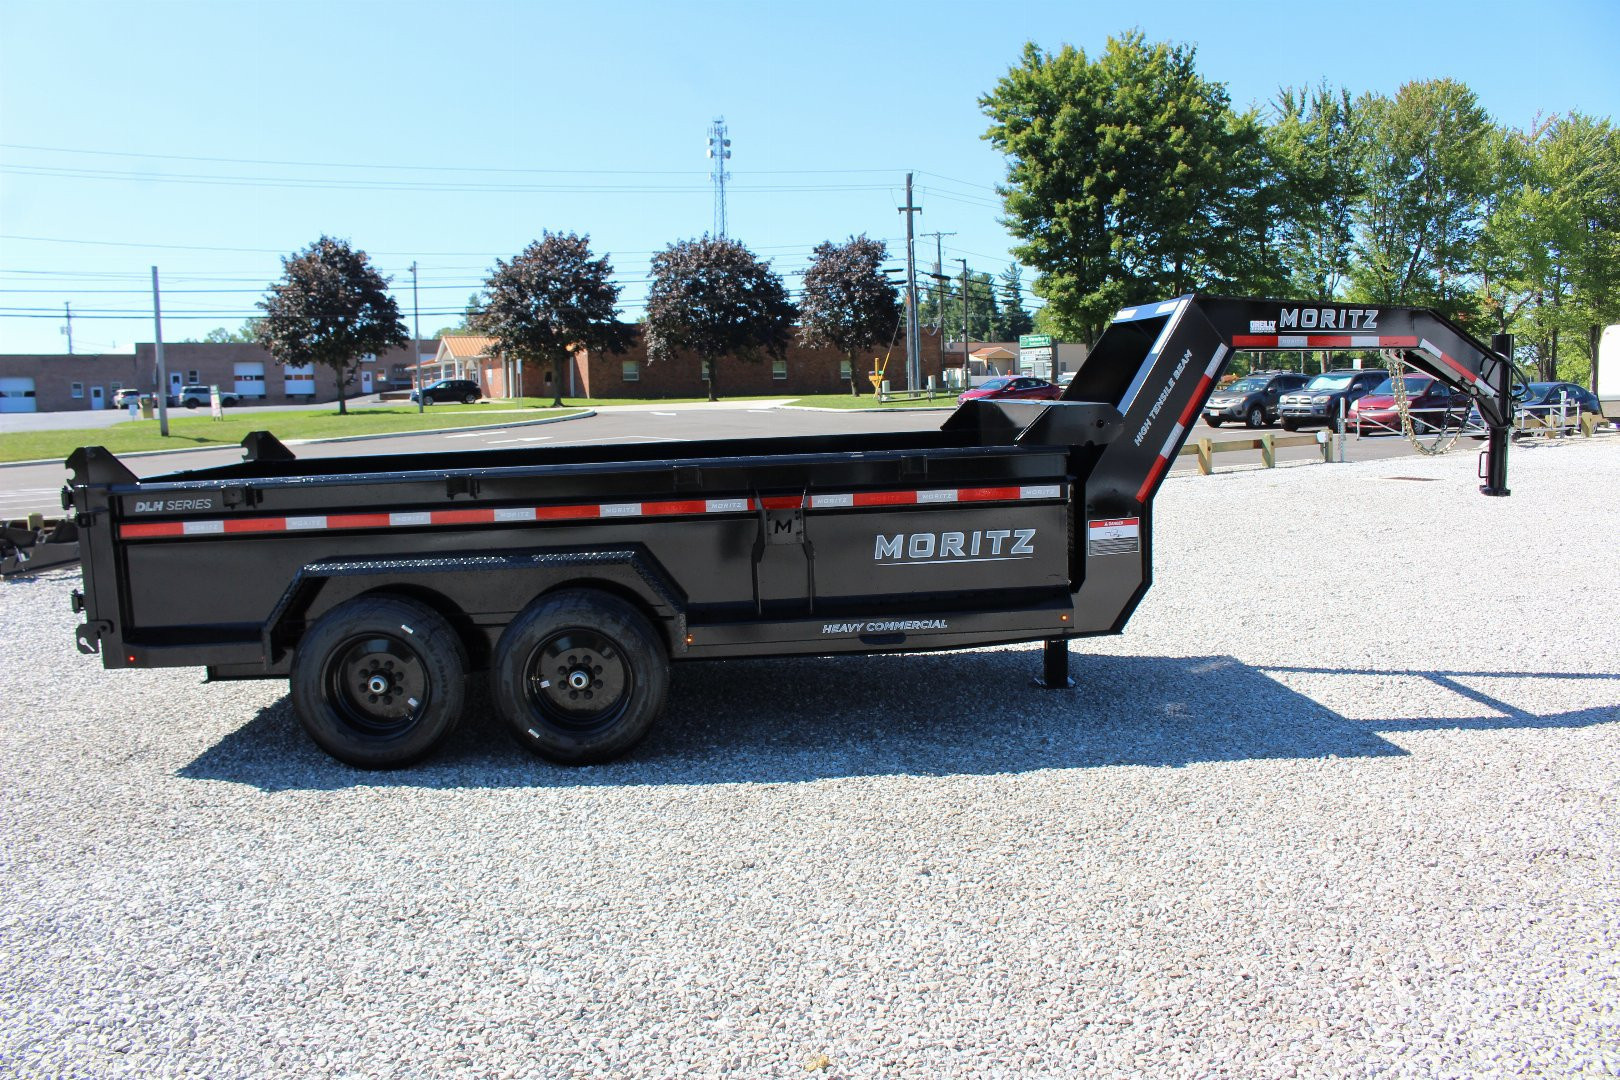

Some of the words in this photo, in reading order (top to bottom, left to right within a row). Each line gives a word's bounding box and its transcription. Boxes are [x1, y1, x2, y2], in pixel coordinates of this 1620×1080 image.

[1279, 308, 1379, 329] MORITZ
[1133, 418, 1152, 447] HIGH
[1148, 377, 1176, 420] TENSILE
[1172, 348, 1193, 380] BEAM
[135, 501, 164, 512] DLH
[165, 499, 212, 511] SERIES
[774, 519, 793, 534] M
[875, 529, 1036, 560] MORITZ
[822, 622, 865, 633] HEAVY
[866, 619, 948, 632] COMMERCIAL
